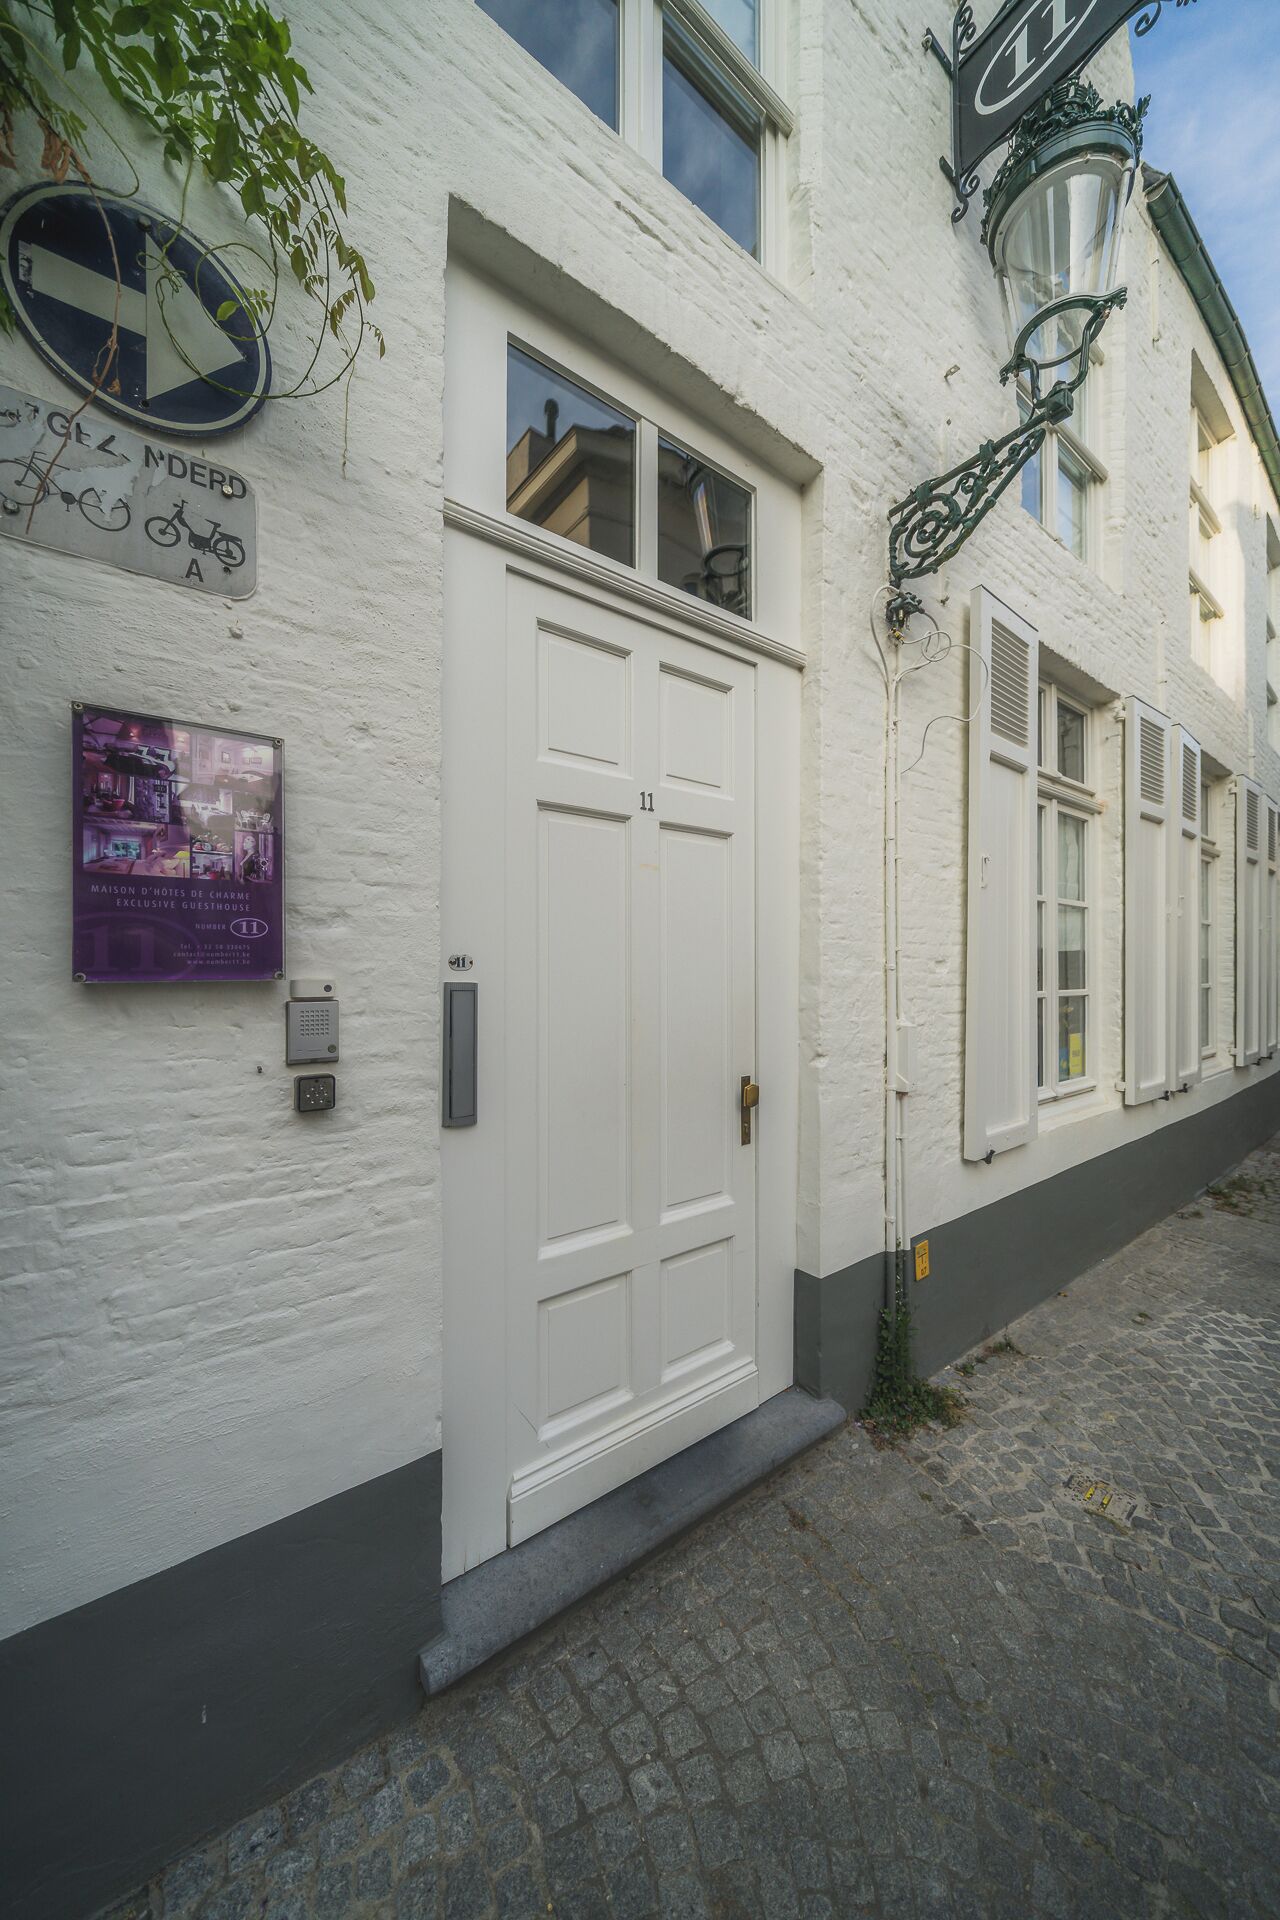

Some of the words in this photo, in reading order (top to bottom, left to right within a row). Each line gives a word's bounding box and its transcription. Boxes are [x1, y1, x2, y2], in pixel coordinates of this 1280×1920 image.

[1004, 0, 1077, 89] 11
[185, 558, 204, 583] A
[639, 791, 655, 812] 11
[90, 884, 136, 895] MAISON
[141, 886, 186, 898] D'HÔTES
[190, 889, 204, 899] DE
[209, 890, 251, 901] CHARME
[115, 898, 176, 909] EXCLUSIVE
[181, 901, 251, 912] GUESTHOUSE
[194, 922, 227, 931] NUMBER
[239, 920, 260, 934] 11
[455, 956, 467, 968] 11
